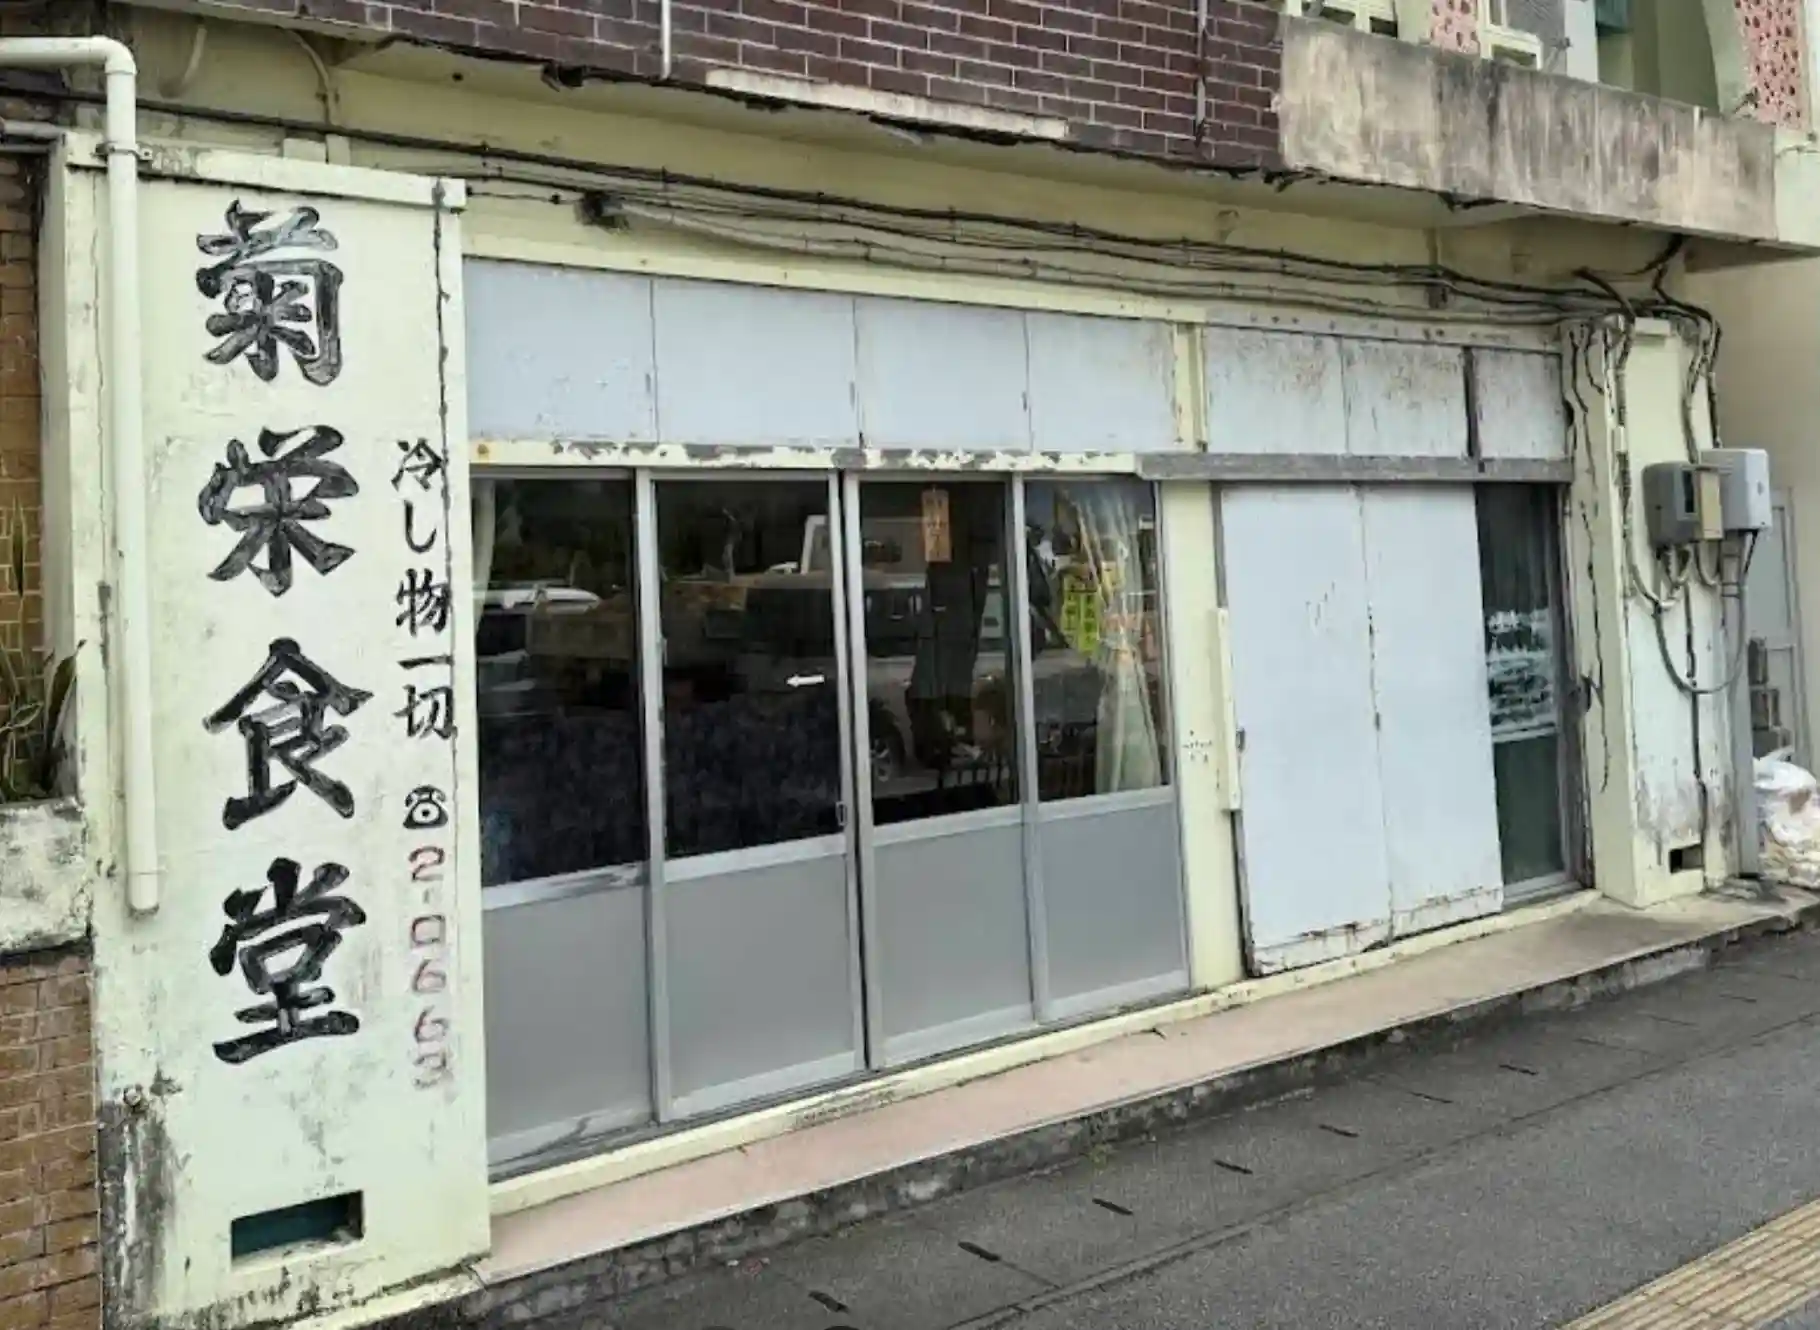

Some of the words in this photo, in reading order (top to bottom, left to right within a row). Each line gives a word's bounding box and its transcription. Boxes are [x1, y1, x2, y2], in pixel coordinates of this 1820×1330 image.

[196, 199, 374, 1064] 菊栄食堂
[392, 438, 456, 740] 冷し物一切
